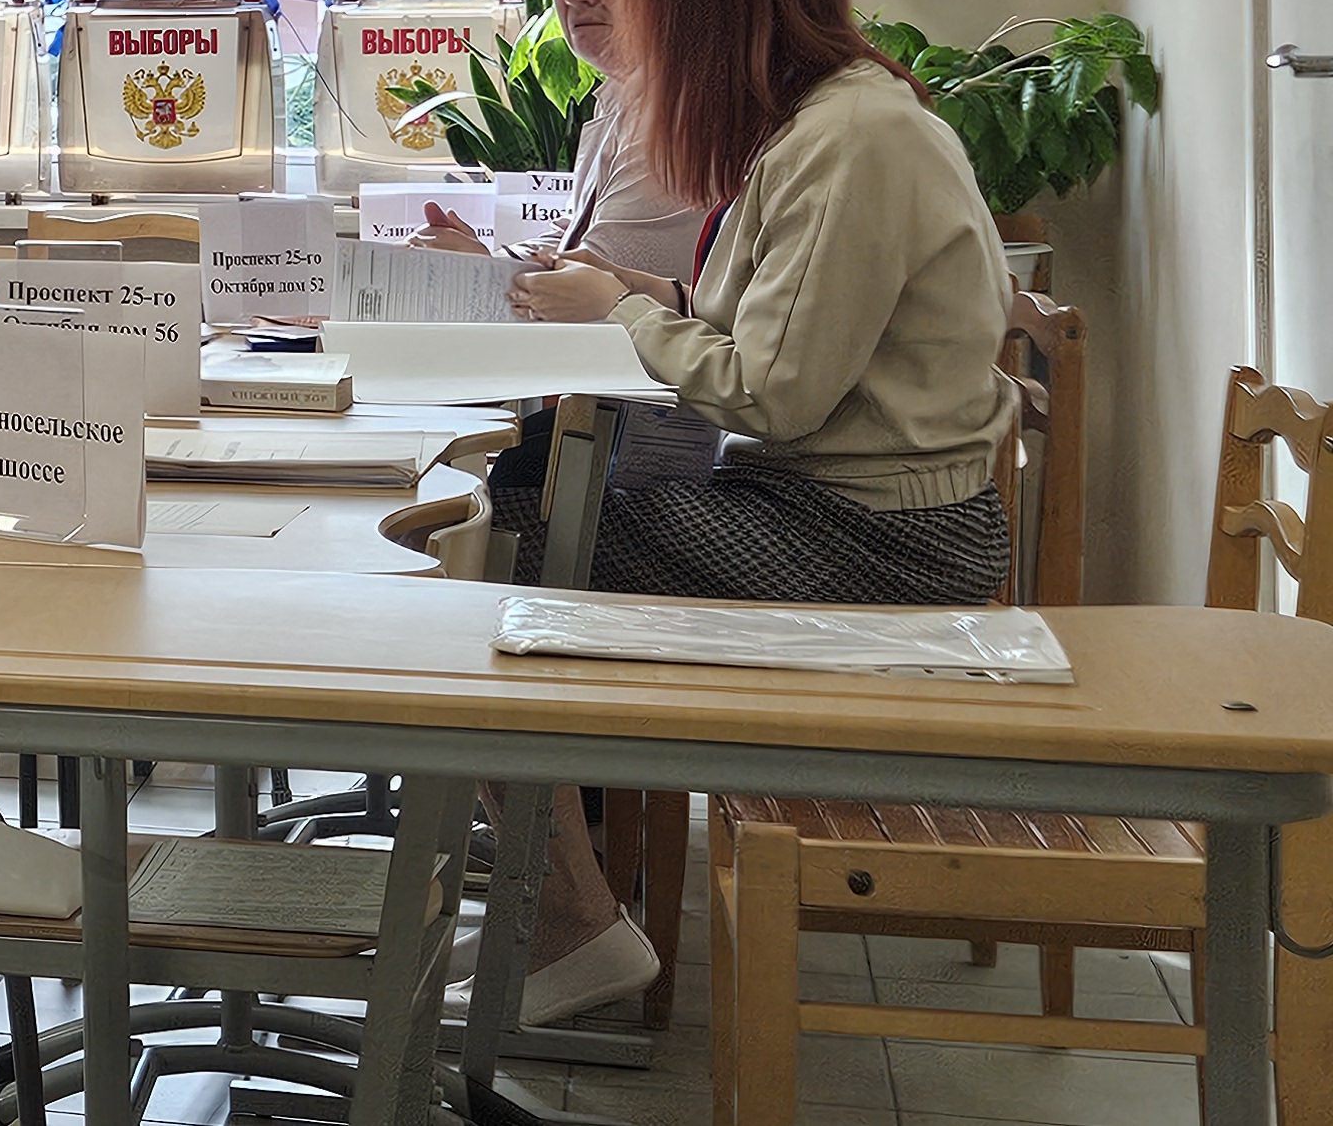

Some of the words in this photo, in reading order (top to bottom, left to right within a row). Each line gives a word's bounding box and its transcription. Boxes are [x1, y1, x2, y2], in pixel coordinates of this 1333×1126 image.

[109, 28, 218, 55] ВЫБОРЫ
[362, 28, 470, 54] ВЫБОРЫ
[212, 251, 282, 270] Проспект
[285, 250, 322, 265] 25-го
[8, 280, 114, 306] Проспект
[120, 285, 176, 306] 25-го
[211, 277, 275, 297] Октября
[278, 281, 305, 293] дом
[310, 276, 325, 292] 52
[154, 322, 179, 342] 56
